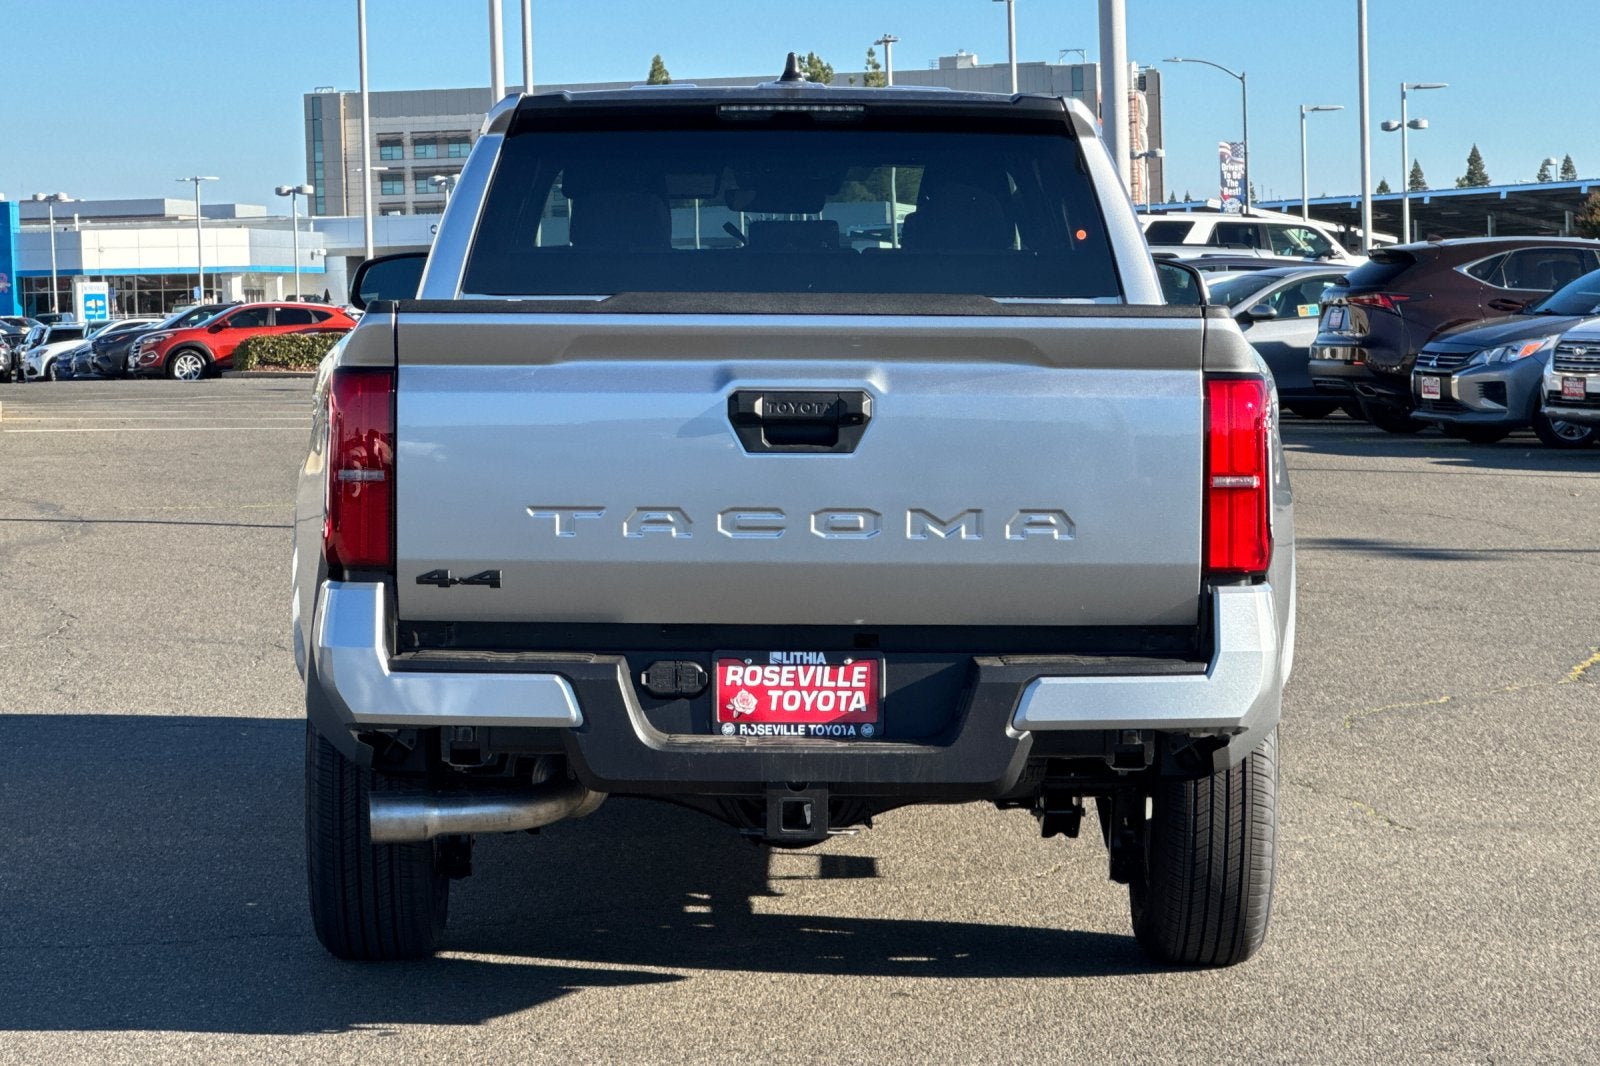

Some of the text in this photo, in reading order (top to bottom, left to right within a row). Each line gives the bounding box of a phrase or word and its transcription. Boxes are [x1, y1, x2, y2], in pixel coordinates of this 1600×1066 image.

[1223, 171, 1241, 179] To Be
[1224, 187, 1241, 195] Best!
[766, 402, 832, 414] TOYOTA
[526, 506, 1076, 540] TACOMA
[783, 652, 826, 664] LITHIA
[726, 666, 867, 687] ROSEVILLE
[767, 690, 867, 711] TOYOTA
[740, 725, 856, 735] ROSEVILLE TOYOTA
